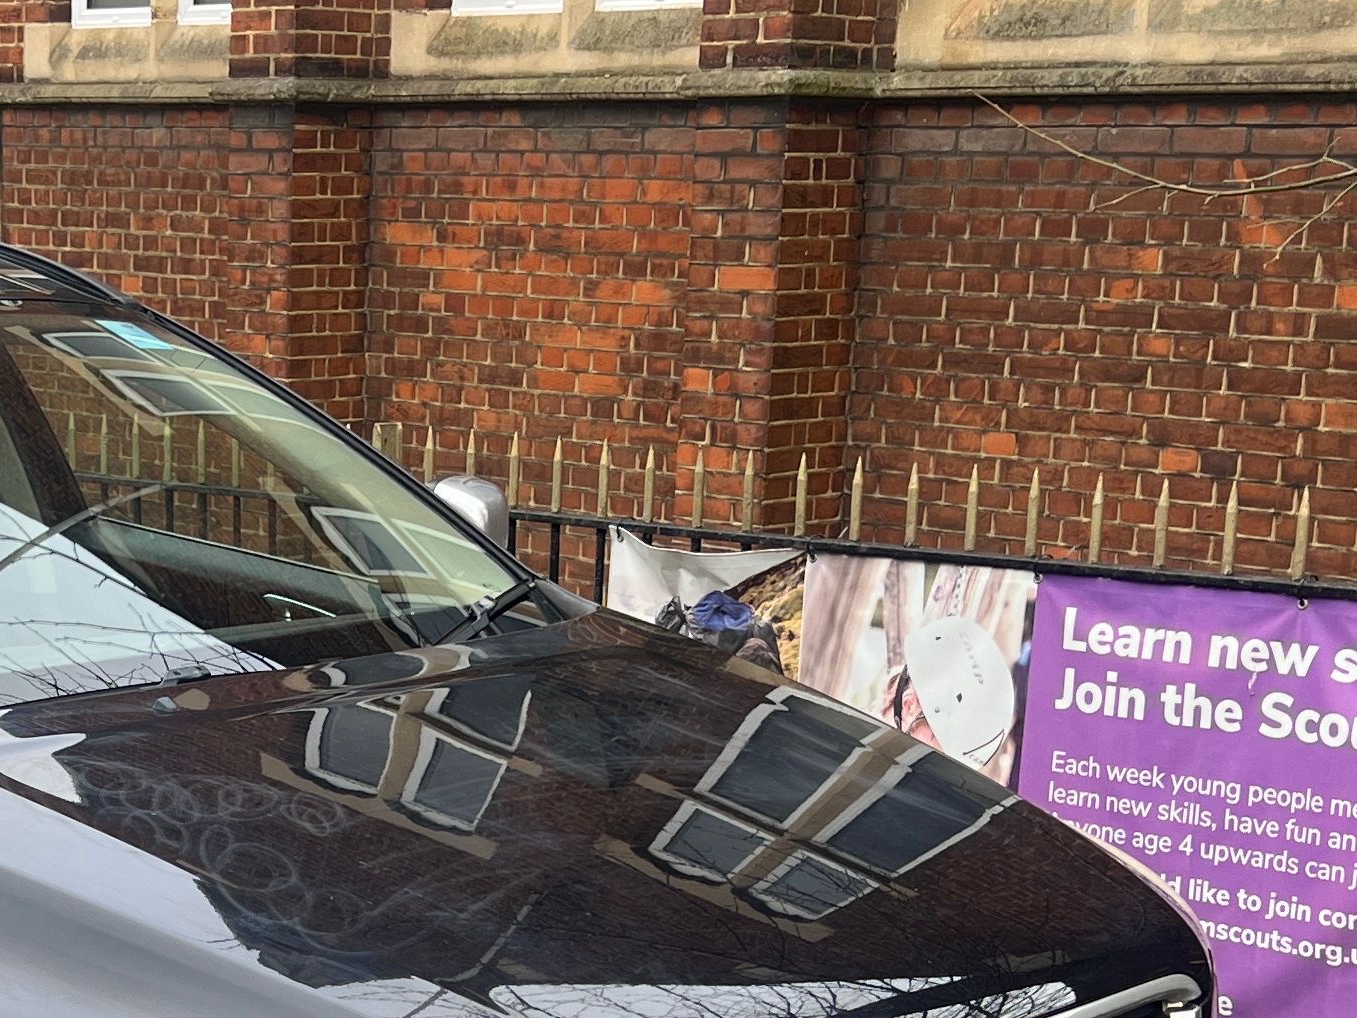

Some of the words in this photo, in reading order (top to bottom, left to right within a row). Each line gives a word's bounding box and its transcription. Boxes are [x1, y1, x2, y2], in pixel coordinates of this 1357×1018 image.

[1062, 606, 1192, 665] Learn
[1207, 635, 1320, 678] new
[1054, 667, 1146, 721] Join
[1160, 682, 1243, 733] the
[1048, 780, 1100, 810] learn
[1105, 795, 1153, 818] new
[1157, 799, 1217, 832] skills,
[1224, 808, 1280, 836] have
[1285, 818, 1321, 846] fun
[1051, 750, 1100, 779] Each
[1106, 764, 1165, 789] week
[1170, 774, 1241, 804] young
[1247, 785, 1324, 814] people
[1051, 811, 1127, 845] one
[1131, 831, 1172, 855] age
[1178, 834, 1194, 856] 4
[1200, 842, 1300, 875] upwards
[1304, 861, 1345, 884] can
[1188, 878, 1230, 906] like
[1236, 888, 1262, 912] to
[1264, 891, 1312, 923] join
